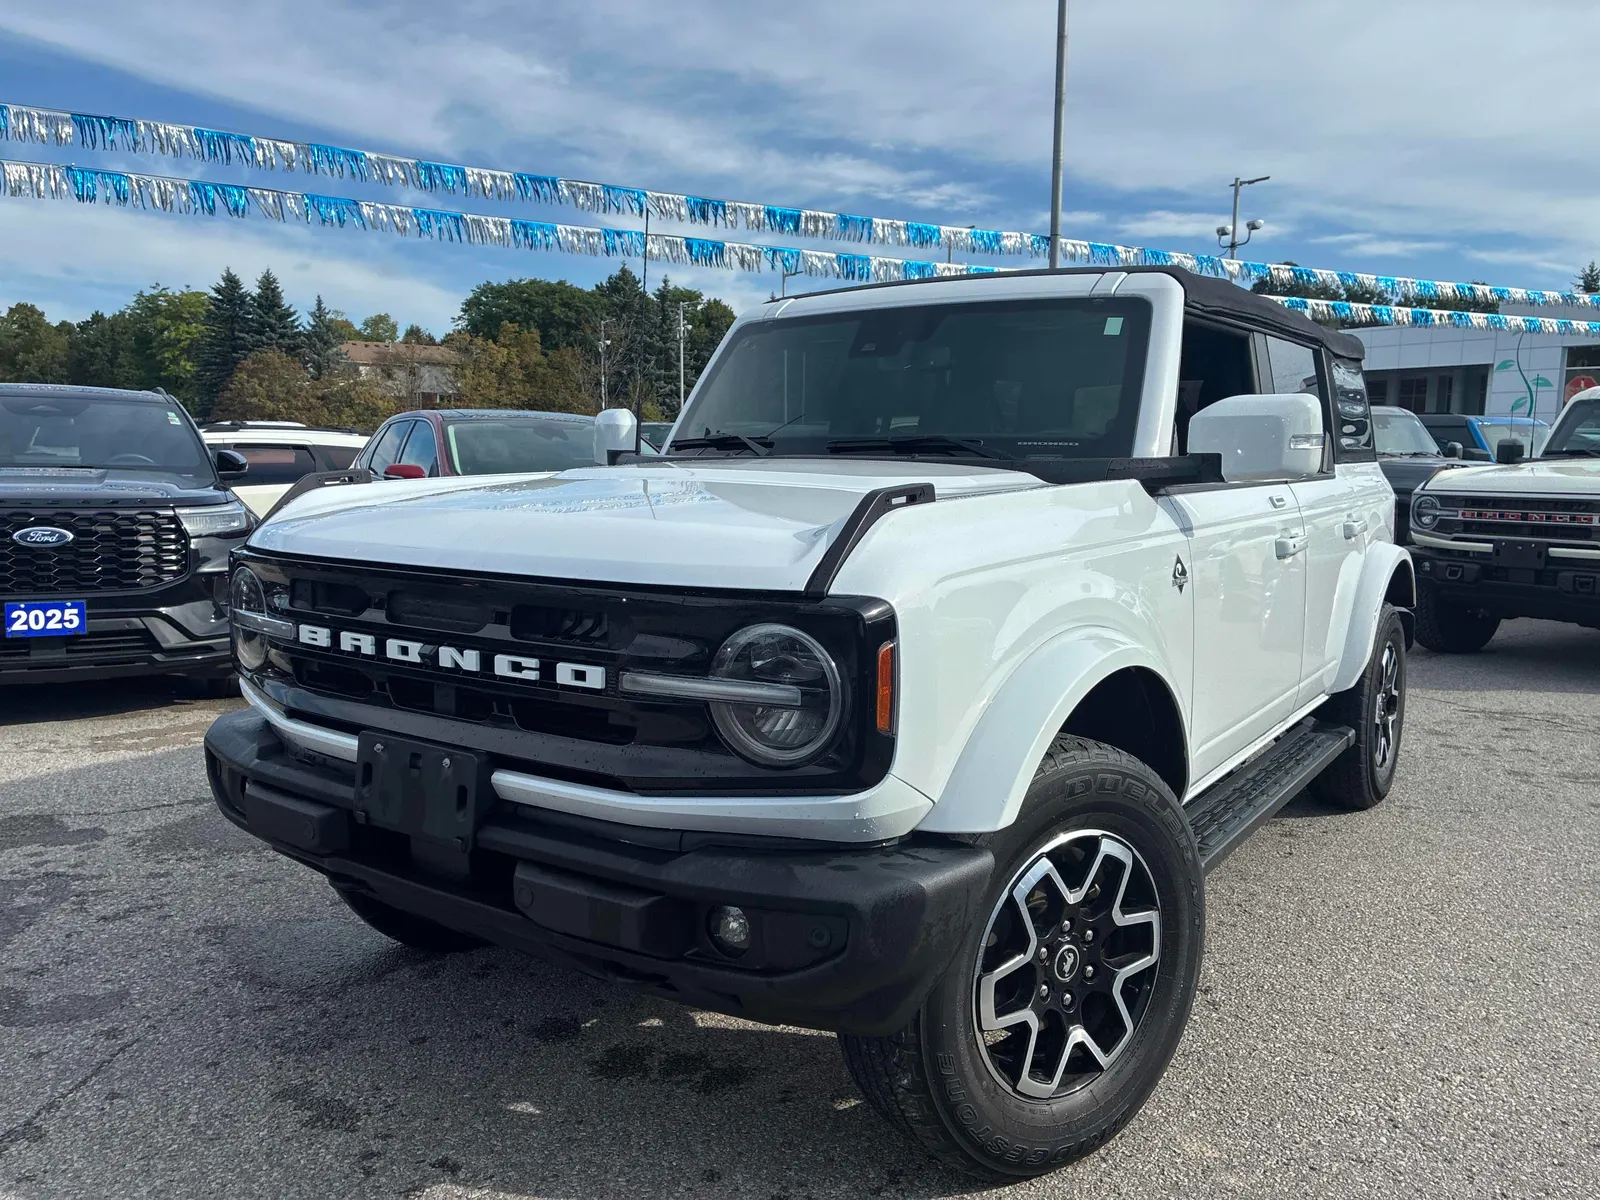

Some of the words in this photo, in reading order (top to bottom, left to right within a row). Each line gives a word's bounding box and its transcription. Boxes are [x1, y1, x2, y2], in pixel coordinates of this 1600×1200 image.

[27, 530, 59, 542] Ford
[1461, 510, 1594, 523] BRONCO
[11, 608, 80, 631] 2025
[299, 624, 606, 689] BRONCO
[1064, 773, 1193, 864] DUELER
[936, 1053, 1131, 1166] BRIDGESTONE
